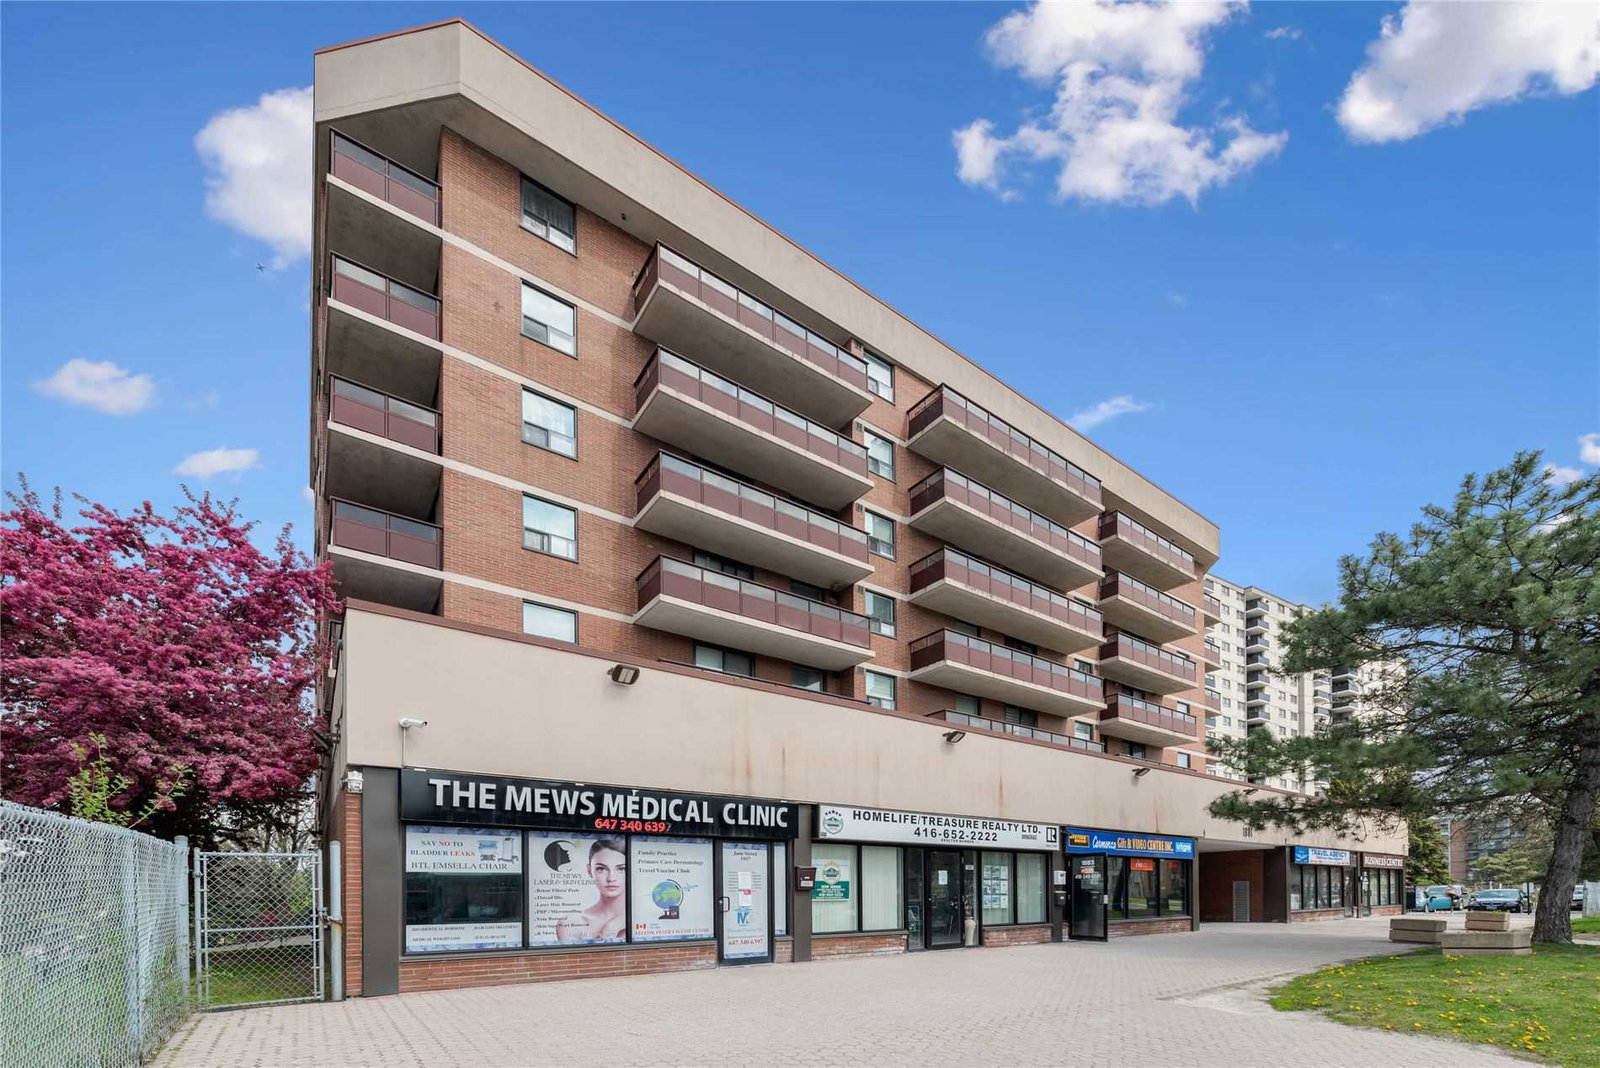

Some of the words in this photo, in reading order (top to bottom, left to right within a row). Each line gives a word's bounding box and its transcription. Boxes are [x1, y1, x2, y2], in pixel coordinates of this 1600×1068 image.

[428, 778, 497, 810] THE
[504, 785, 596, 816] MEWS
[722, 803, 788, 828] CLINIC
[594, 818, 617, 830] 647
[619, 820, 642, 831] 340
[644, 821, 672, 833] 6397
[982, 820, 1019, 832] REALTY
[1021, 824, 1041, 834] LTD.
[914, 827, 998, 842] 416-652-2222
[1311, 849, 1329, 857] TRAVEL
[1364, 856, 1386, 866] BUSINESS
[1386, 858, 1404, 867] CENTRE
